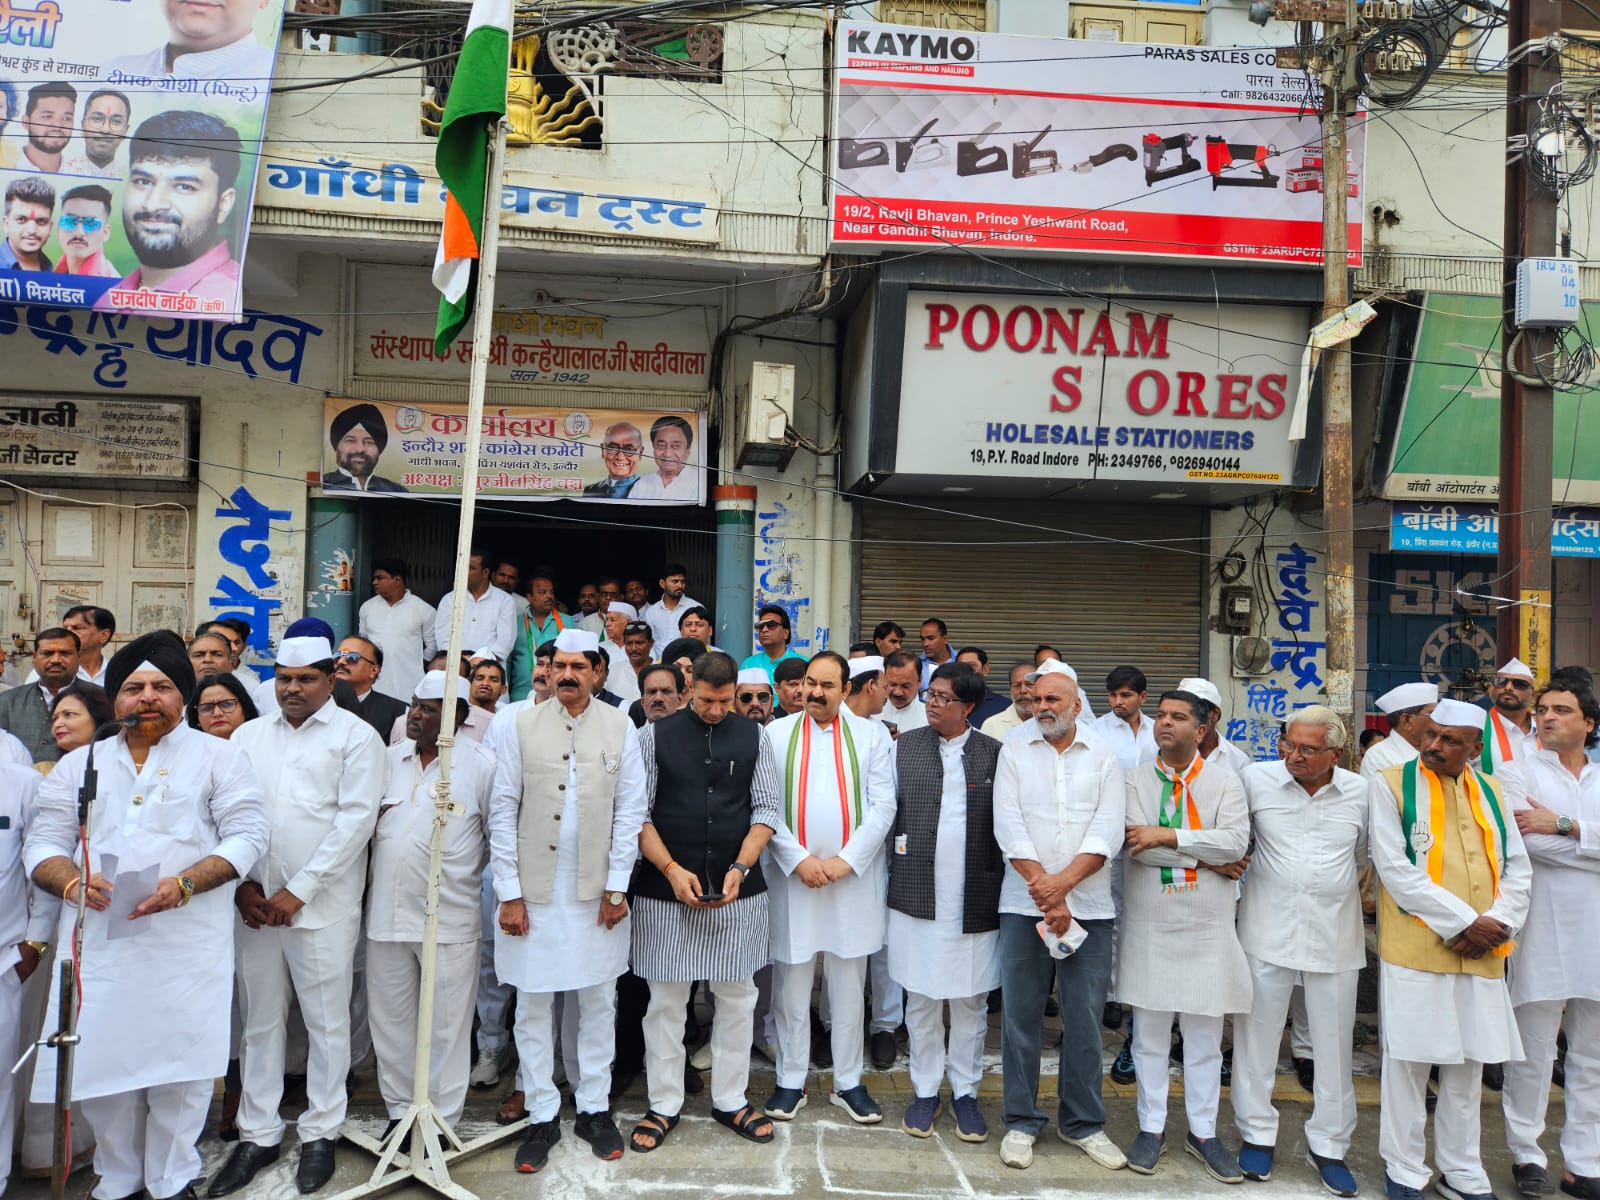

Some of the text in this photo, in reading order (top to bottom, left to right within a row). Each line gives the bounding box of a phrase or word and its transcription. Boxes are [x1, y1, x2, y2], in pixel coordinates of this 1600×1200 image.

[848, 29, 976, 61] KAYMO
[1144, 46, 1196, 62] PARAS
[1200, 51, 1250, 65] SALES
[21, 56, 42, 73] कुंड
[42, 57, 55, 72] से
[57, 62, 100, 79] राजवाड़ा
[924, 64, 940, 72] AND
[941, 65, 970, 75] NAILING
[107, 69, 152, 87] दीपक
[156, 77, 198, 94] जोशी
[1246, 73, 1274, 88] पारस
[1280, 72, 1306, 90] सेल्स
[1221, 89, 1243, 100] Call:
[597, 193, 706, 231] ट्रस्ट
[843, 204, 1129, 233] 19/2, Ravji Bhavan, Prince Yeshwant Road,
[842, 221, 1037, 243] Near Gandhi Bhavan, Indore.
[1224, 243, 1259, 255] GSTIN:
[25, 281, 85, 303] मित्रमंडल
[110, 288, 158, 307] राजदीप
[160, 292, 198, 311] नाईक
[1563, 293, 1576, 308] 10
[924, 303, 1174, 360] POONAM
[629, 342, 707, 376] खादीवाला
[551, 372, 590, 384] 1942
[402, 437, 445, 453] इन्दौर
[487, 440, 538, 457] कांग्रेस
[541, 442, 585, 458] कमेटी
[1114, 426, 1255, 451] STATIONERS
[23, 443, 79, 466] सेन्टर
[1011, 450, 1041, 465] Road
[1043, 451, 1079, 466] Indore
[1088, 453, 1109, 467] PH:
[1111, 455, 1167, 472] 2349766,
[402, 472, 453, 488] अध्यक्ष
[1402, 505, 1460, 532] बॉबी
[1247, 679, 1289, 718] सिंह
